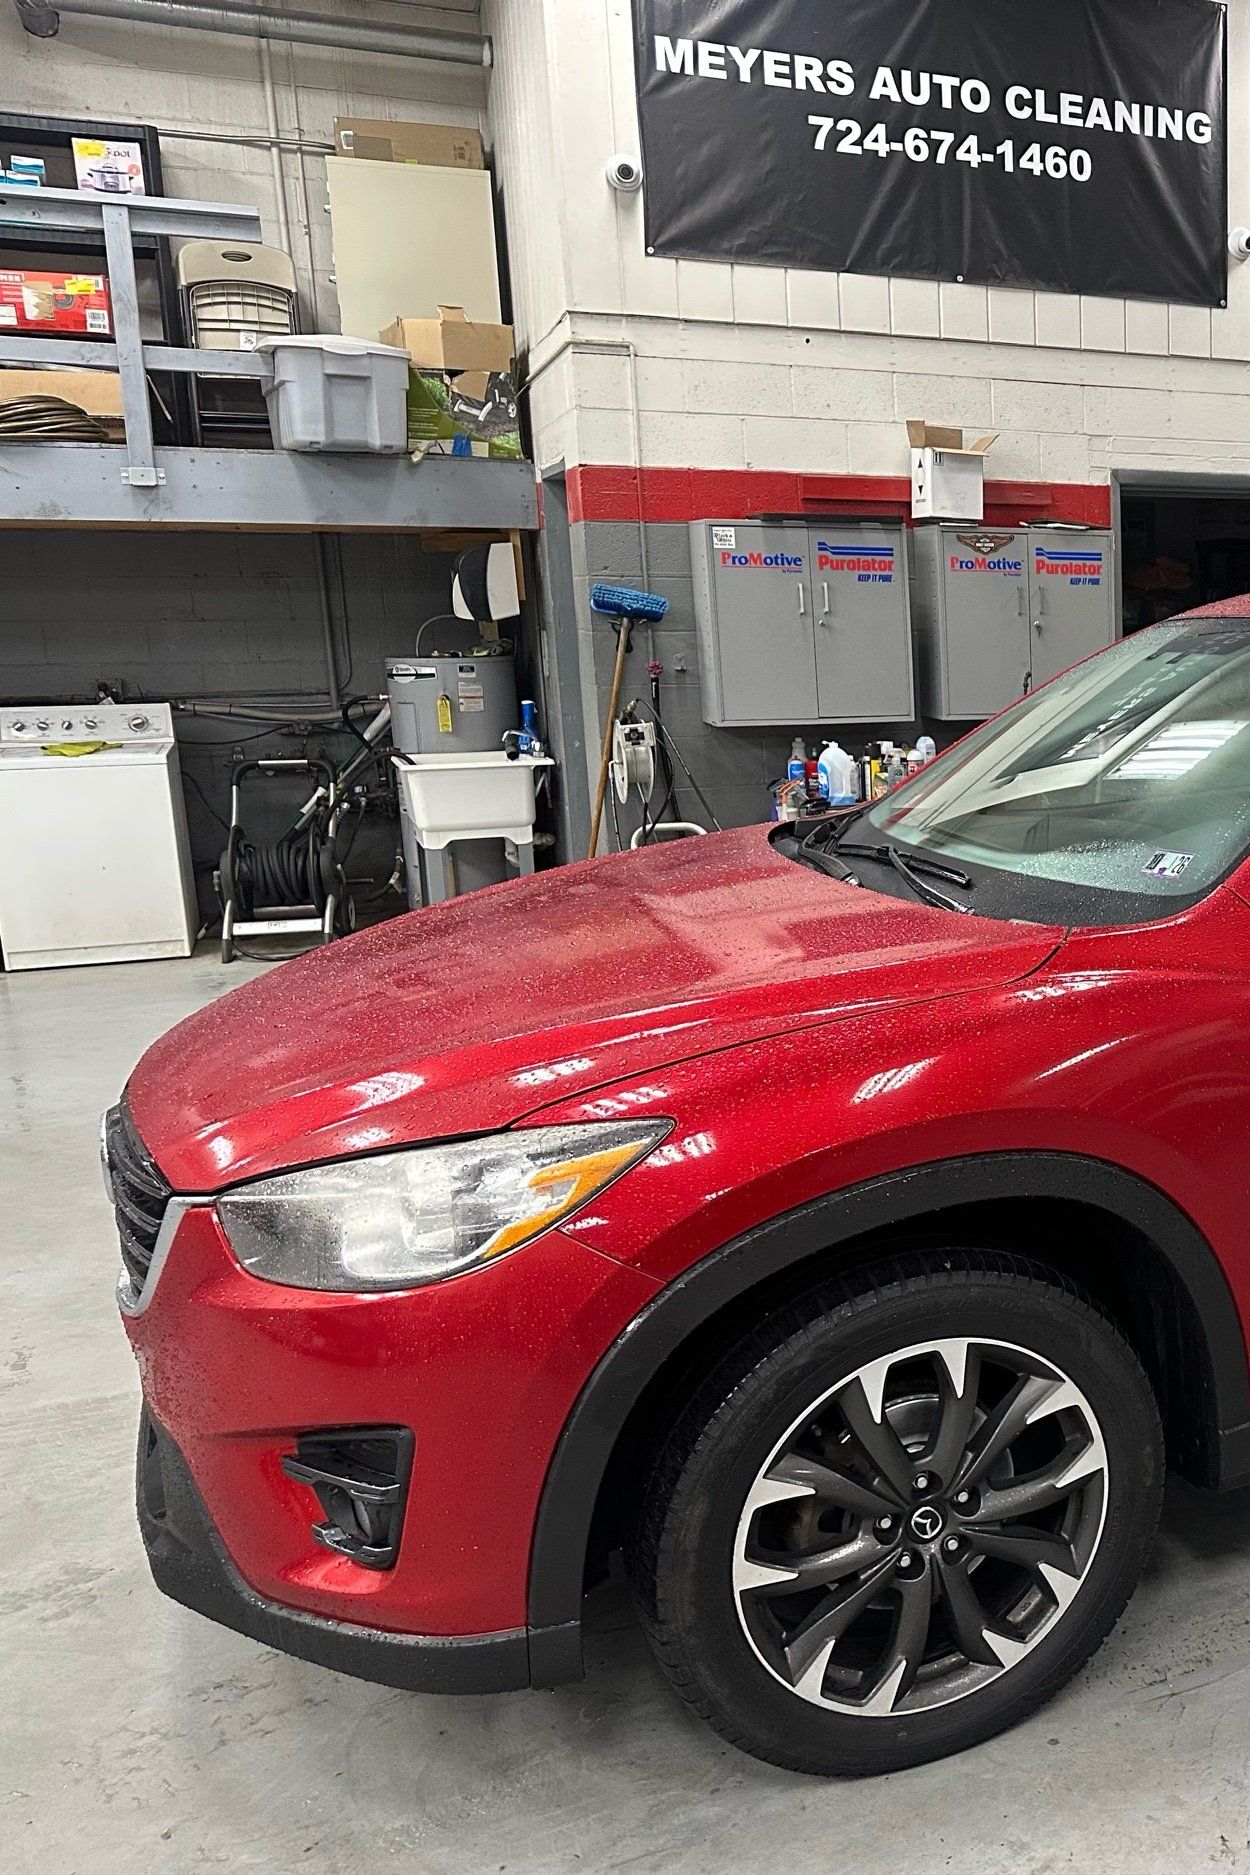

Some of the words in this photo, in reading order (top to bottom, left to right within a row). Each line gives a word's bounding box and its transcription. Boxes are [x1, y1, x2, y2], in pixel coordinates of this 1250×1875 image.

[654, 35, 855, 96] MEYERS
[869, 66, 991, 113] AUTO
[1005, 85, 1212, 144] CLEANING
[808, 115, 1092, 182] 724-674-1460
[721, 552, 802, 567] ProMotive
[818, 554, 895, 572] Purolator
[950, 556, 1022, 571] ProMotive
[1035, 559, 1103, 575] Purolator
[857, 574, 871, 582] KEEP
[871, 574, 877, 582] IT
[878, 575, 893, 583] PURE
[1170, 856, 1190, 874] 26
